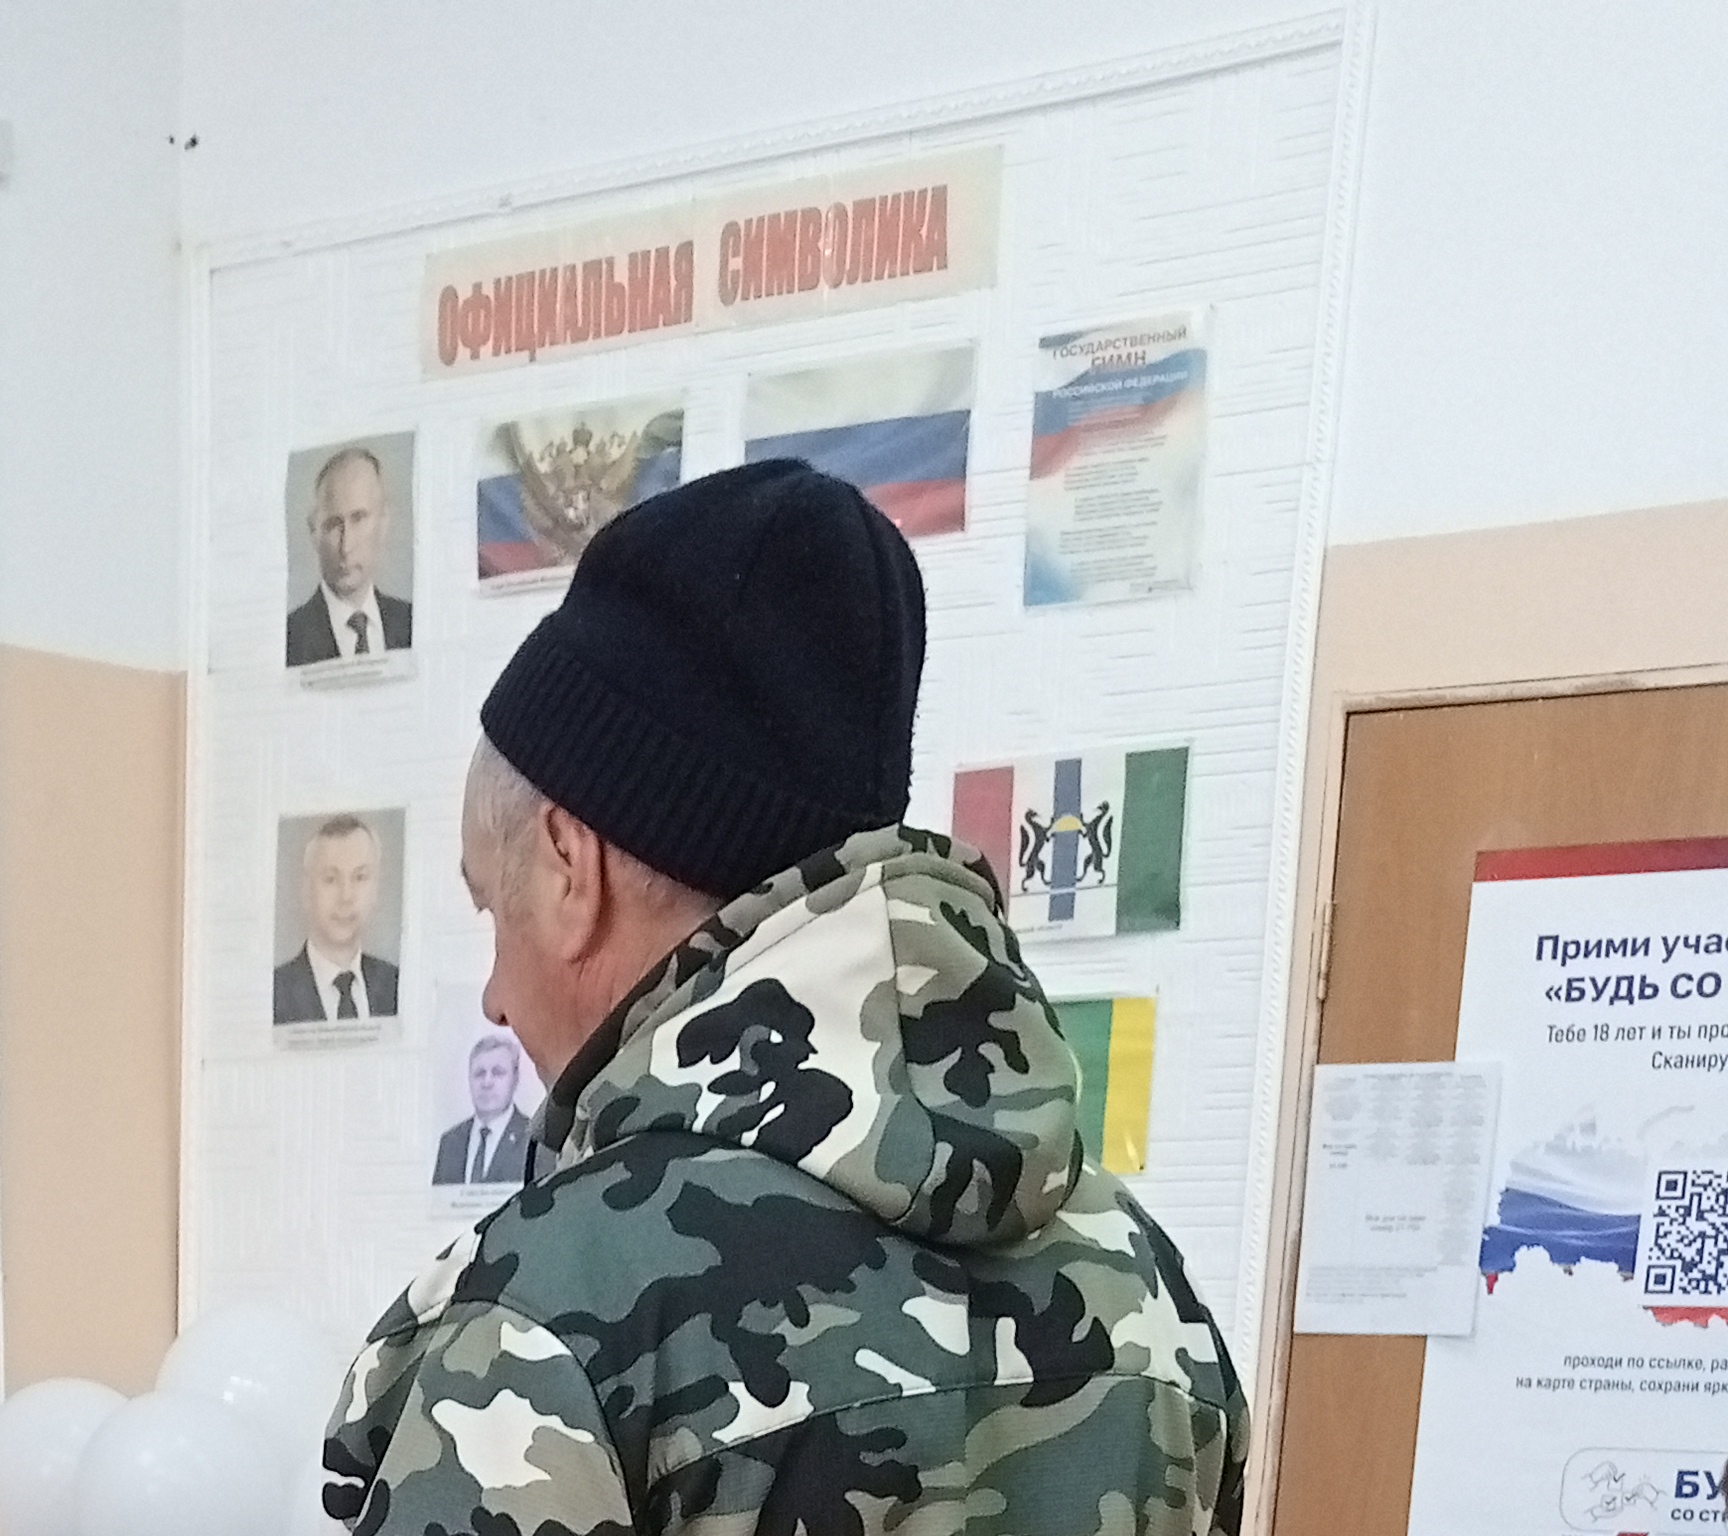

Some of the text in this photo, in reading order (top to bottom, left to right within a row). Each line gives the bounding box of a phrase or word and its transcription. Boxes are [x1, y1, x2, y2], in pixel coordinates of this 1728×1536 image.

[438, 184, 949, 366] ОФИЦИАЛЬНАЯ СИМВОЛИКА
[1053, 326, 1187, 360] ГОСУДАРСТВЕННЫЙ
[1535, 932, 1728, 968] Прими уча
[1544, 971, 1723, 1006] «БУДЬ СО
[1547, 1023, 1587, 1043] Тебе
[1593, 1022, 1610, 1042] 18
[1614, 1025, 1646, 1041] лет
[1651, 1025, 1662, 1041] и
[1668, 1025, 1692, 1040] ты
[1563, 1354, 1622, 1370] проходи
[1627, 1357, 1644, 1369] по
[1649, 1357, 1706, 1372] ссылке,
[1515, 1376, 1532, 1389] на
[1536, 1377, 1574, 1392] карте
[1579, 1378, 1635, 1394] страны,
[1639, 1380, 1699, 1395] сохрани
[1670, 1508, 1695, 1521] СО
